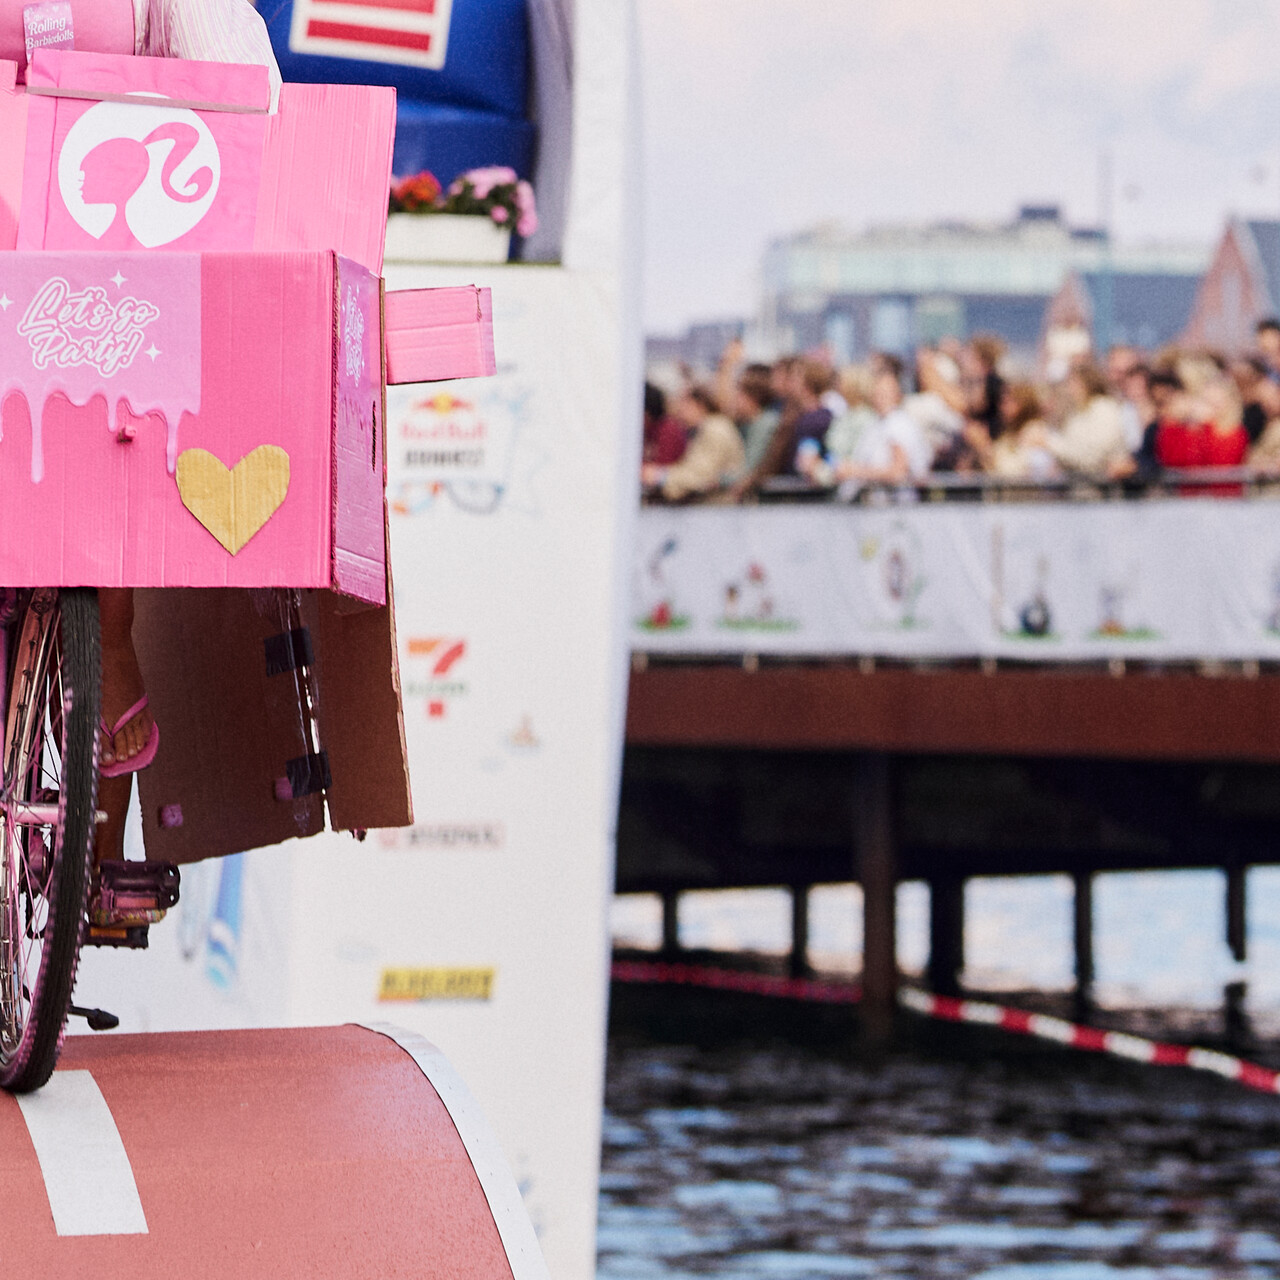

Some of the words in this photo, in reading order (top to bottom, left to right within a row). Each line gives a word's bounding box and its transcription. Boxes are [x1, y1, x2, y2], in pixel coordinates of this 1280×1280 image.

[28, 17, 66, 36] Rolling
[18, 278, 114, 333] Let's
[113, 297, 158, 333] go
[30, 329, 143, 375] Party!
